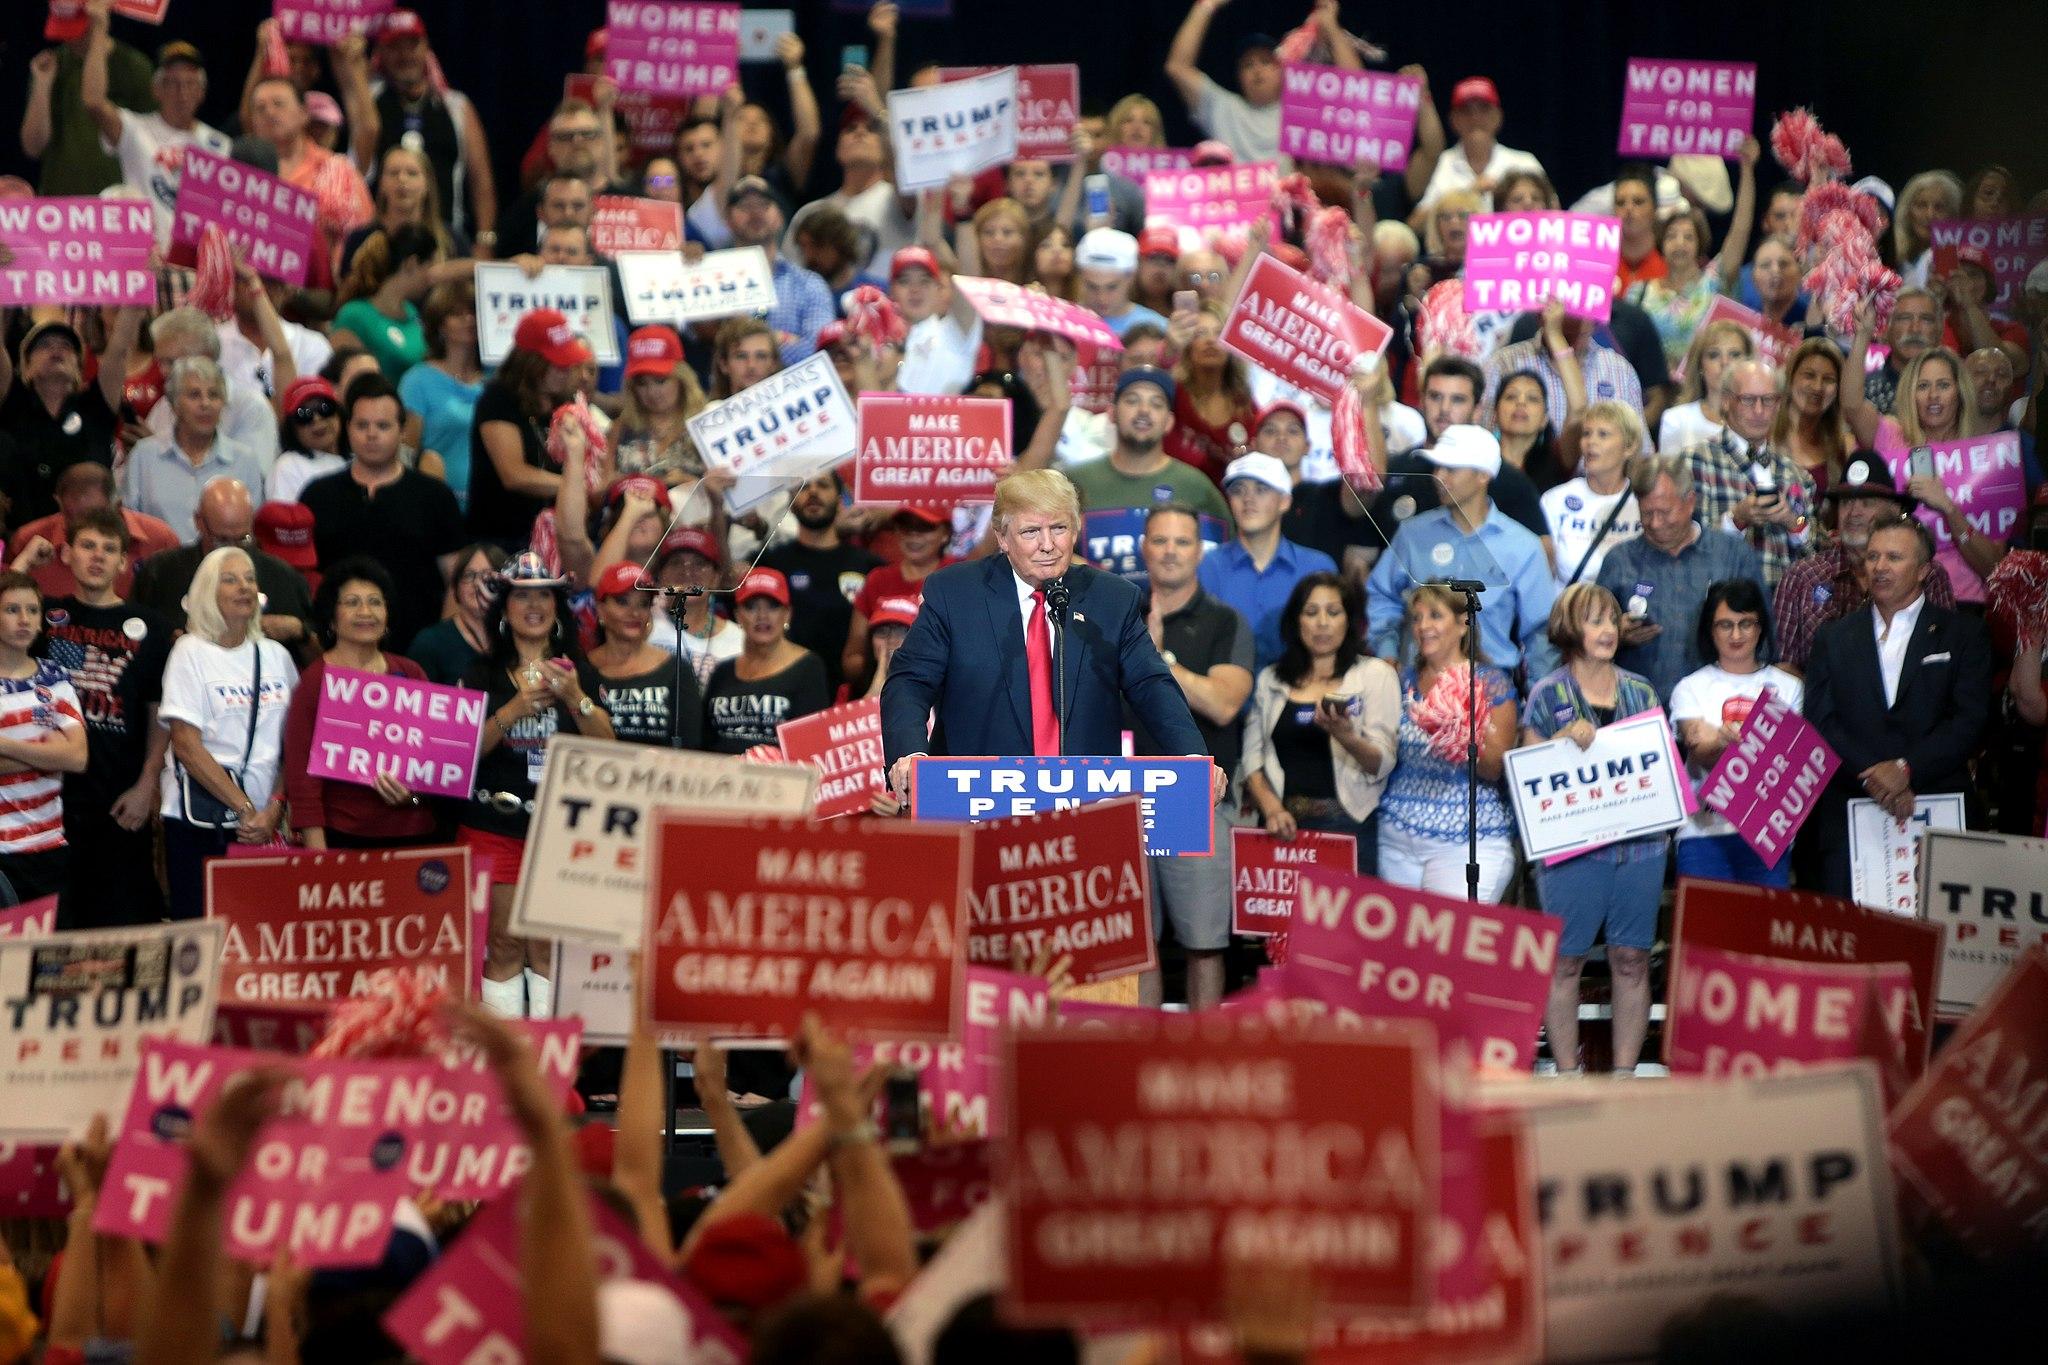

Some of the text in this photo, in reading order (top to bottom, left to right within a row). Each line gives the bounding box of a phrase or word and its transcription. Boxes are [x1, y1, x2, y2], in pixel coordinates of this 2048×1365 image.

[609, 3, 740, 34] WOMEN
[647, 36, 697, 57] FOR
[613, 59, 732, 89] TRUMP
[1287, 67, 1421, 109] WOMEN
[1629, 64, 1756, 97] WOMEN
[902, 97, 1011, 136] TRUMP
[1321, 105, 1371, 129] FOR
[1665, 99, 1713, 121] FOR
[1286, 126, 1405, 163] TRUMP
[1629, 123, 1746, 153] TRUMP
[185, 150, 317, 224] WOMEN
[1146, 166, 1279, 200] WOMEN
[0, 204, 152, 233] WOMEN
[221, 198, 270, 231] FOR
[1189, 199, 1237, 221] FOR
[48, 240, 103, 262] FOR
[1470, 217, 1622, 250] WOMEN
[1514, 251, 1570, 272] FOR
[5, 269, 147, 298] TRUMP
[489, 291, 600, 311] TRUMP
[1474, 278, 1607, 310] TRUMP
[1290, 290, 1342, 329] MAKE
[1239, 319, 1346, 389] GREAT AGAIN
[711, 384, 833, 457] TRUMP
[908, 414, 960, 432] MAKE
[731, 412, 831, 469] PENCE
[861, 435, 1006, 462] AMERICA
[870, 467, 995, 486] GREAT AGAIN
[324, 672, 484, 727] WOMEN
[367, 719, 424, 749] FOR
[828, 713, 880, 743] MAKE
[321, 740, 465, 788] TRUMP
[1705, 690, 1791, 811] WOMEN
[947, 769, 1179, 793] TRUMP
[1524, 750, 1662, 797] TRUMP
[1754, 752, 1791, 802] FOR
[969, 798, 1156, 817] PENE
[1539, 775, 1654, 812] PENCE
[1754, 745, 1827, 853] TRUMP
[758, 849, 867, 887] MAKE
[1000, 835, 1078, 873] MAKE
[1274, 846, 1318, 864] MAKE
[299, 879, 386, 911] MAKE
[965, 860, 1144, 927] MERICA
[218, 912, 465, 965] AMERICA
[655, 889, 956, 957] AMERICA
[1050, 911, 1134, 954] AGAIN
[1299, 877, 1559, 975] WOMEN
[1770, 918, 1859, 960] MAKE
[235, 970, 341, 1002] GREAT
[673, 953, 937, 1001] GREAT AGAIN
[1358, 958, 1455, 1011] FOR
[5, 984, 202, 1030] TRUMP
[1136, 1058, 1293, 1114] MAKE
[426, 1090, 487, 1125] OR
[254, 1140, 329, 1184] OR
[1018, 1119, 1428, 1206] AMERICA
[1034, 1208, 1216, 1270] GREAT
[1221, 1213, 1400, 1270] AGAIN
[1554, 1213, 1834, 1268] PENCE
